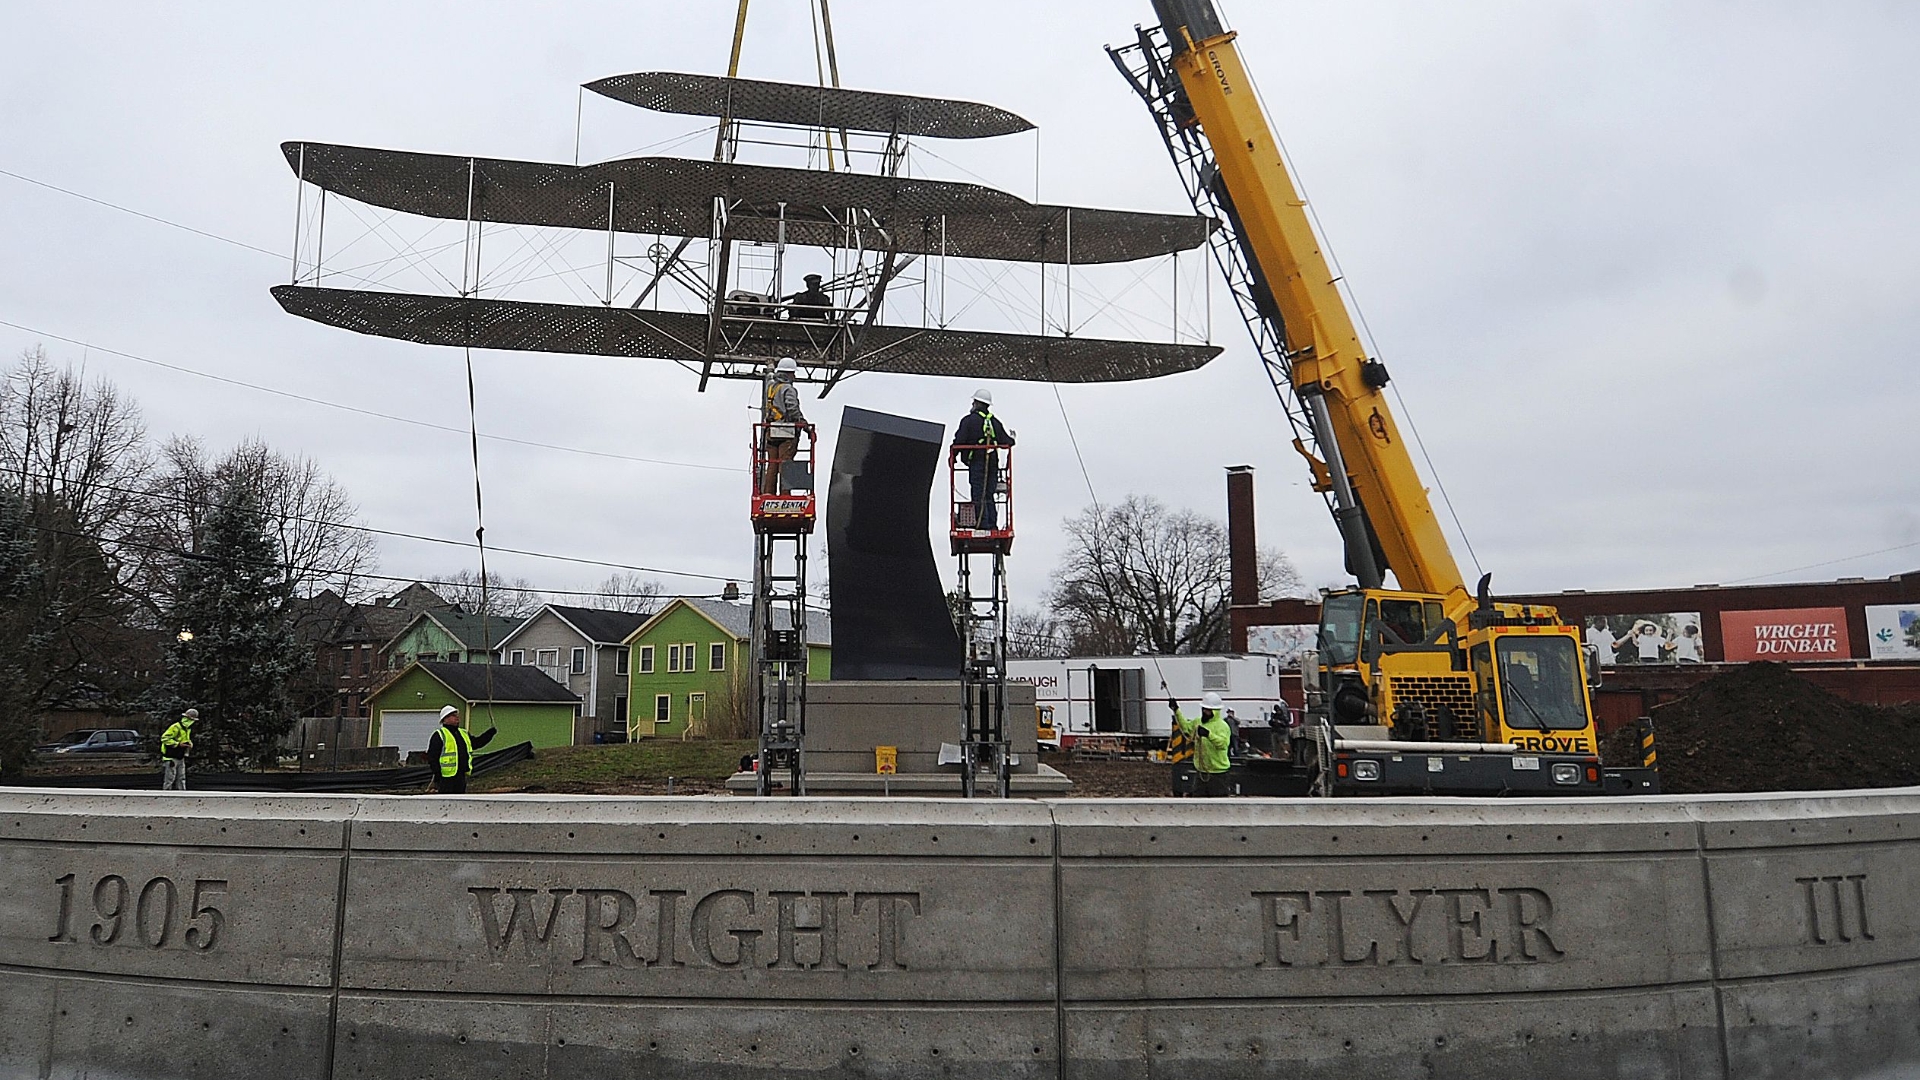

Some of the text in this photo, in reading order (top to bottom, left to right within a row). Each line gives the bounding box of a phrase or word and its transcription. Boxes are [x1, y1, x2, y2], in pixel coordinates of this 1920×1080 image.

[1209, 51, 1232, 95] GROVE
[781, 501, 807, 509] RENTAL
[1754, 624, 1837, 639] WRIGHT-
[1756, 639, 1837, 654] DUNBAR
[1509, 737, 1589, 752] GROVE
[49, 871, 1876, 972] 1905 WRIGHT FLYER III
